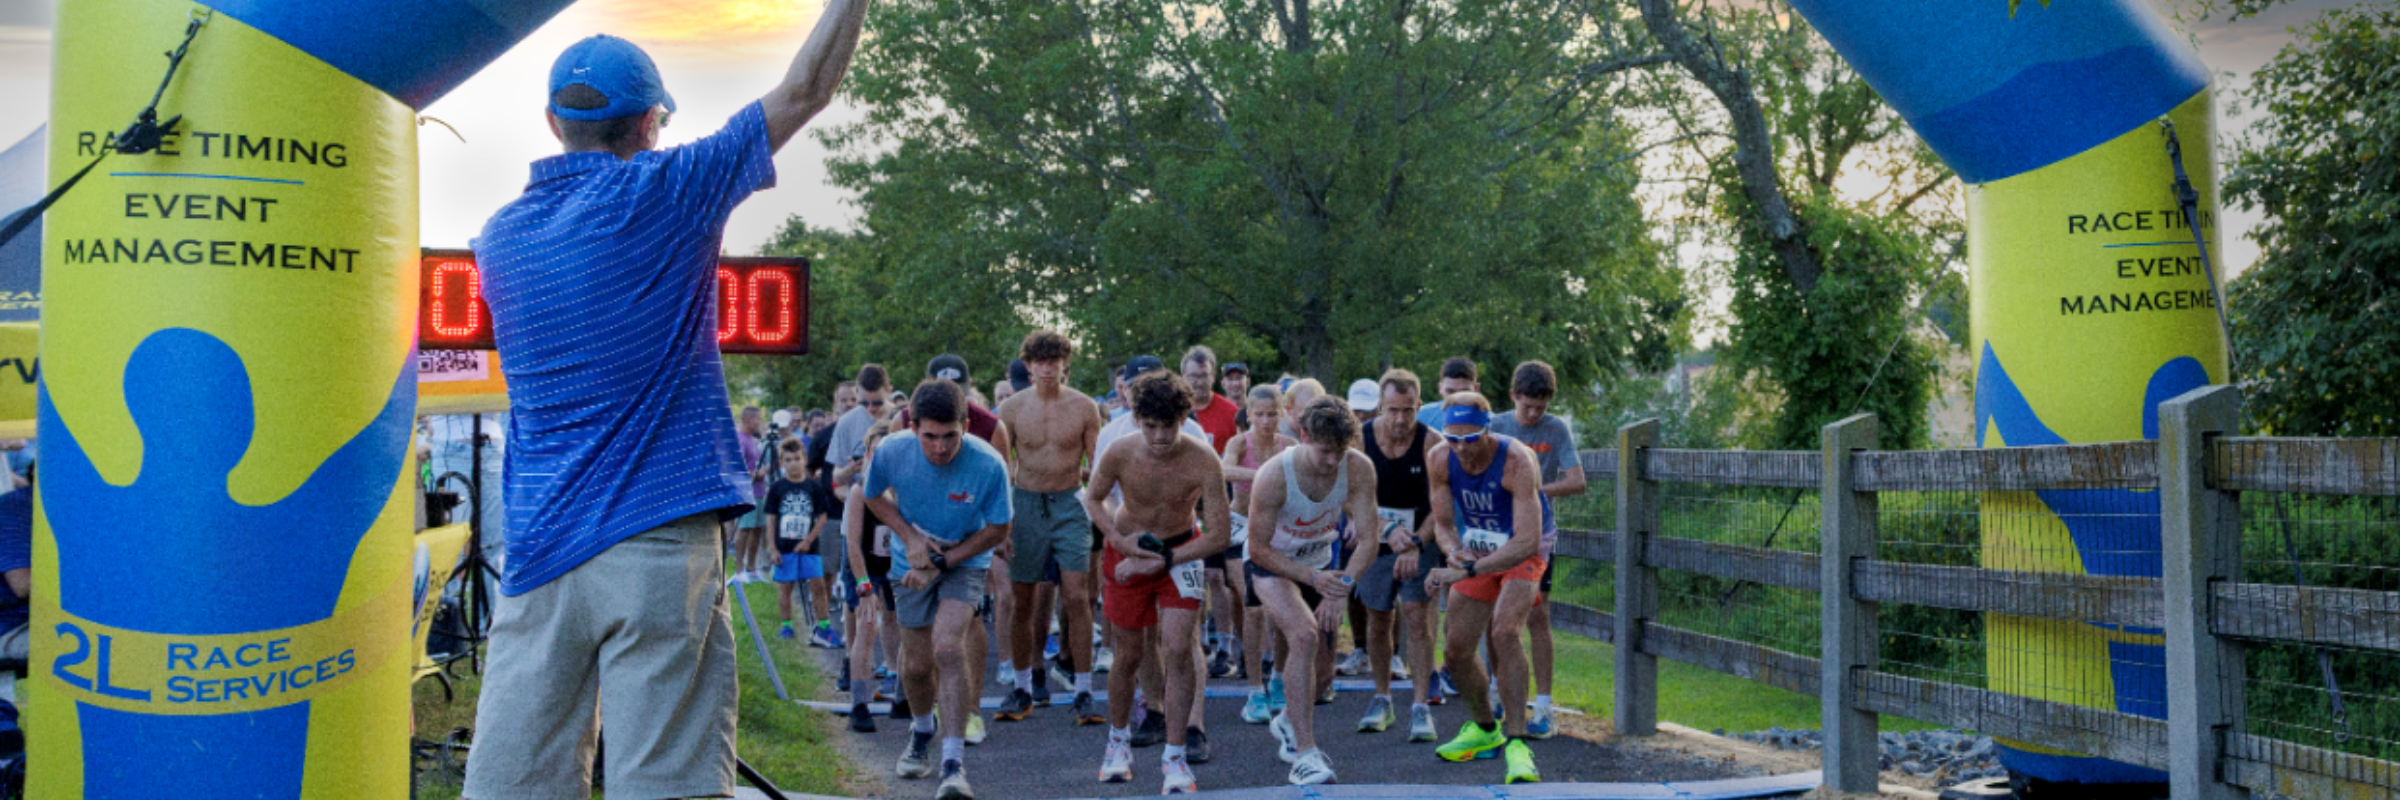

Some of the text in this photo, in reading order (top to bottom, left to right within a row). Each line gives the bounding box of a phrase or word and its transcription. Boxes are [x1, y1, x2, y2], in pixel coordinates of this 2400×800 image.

[78, 131, 347, 167] RAE TIMING
[124, 193, 278, 223] EVENT
[2068, 210, 2154, 235] RACE
[64, 239, 360, 273] MANAGEMENT
[2117, 256, 2203, 278] EVENT
[1462, 489, 1494, 512] DW
[52, 622, 291, 703] 2L RACE
[166, 649, 356, 703] SERVICES
